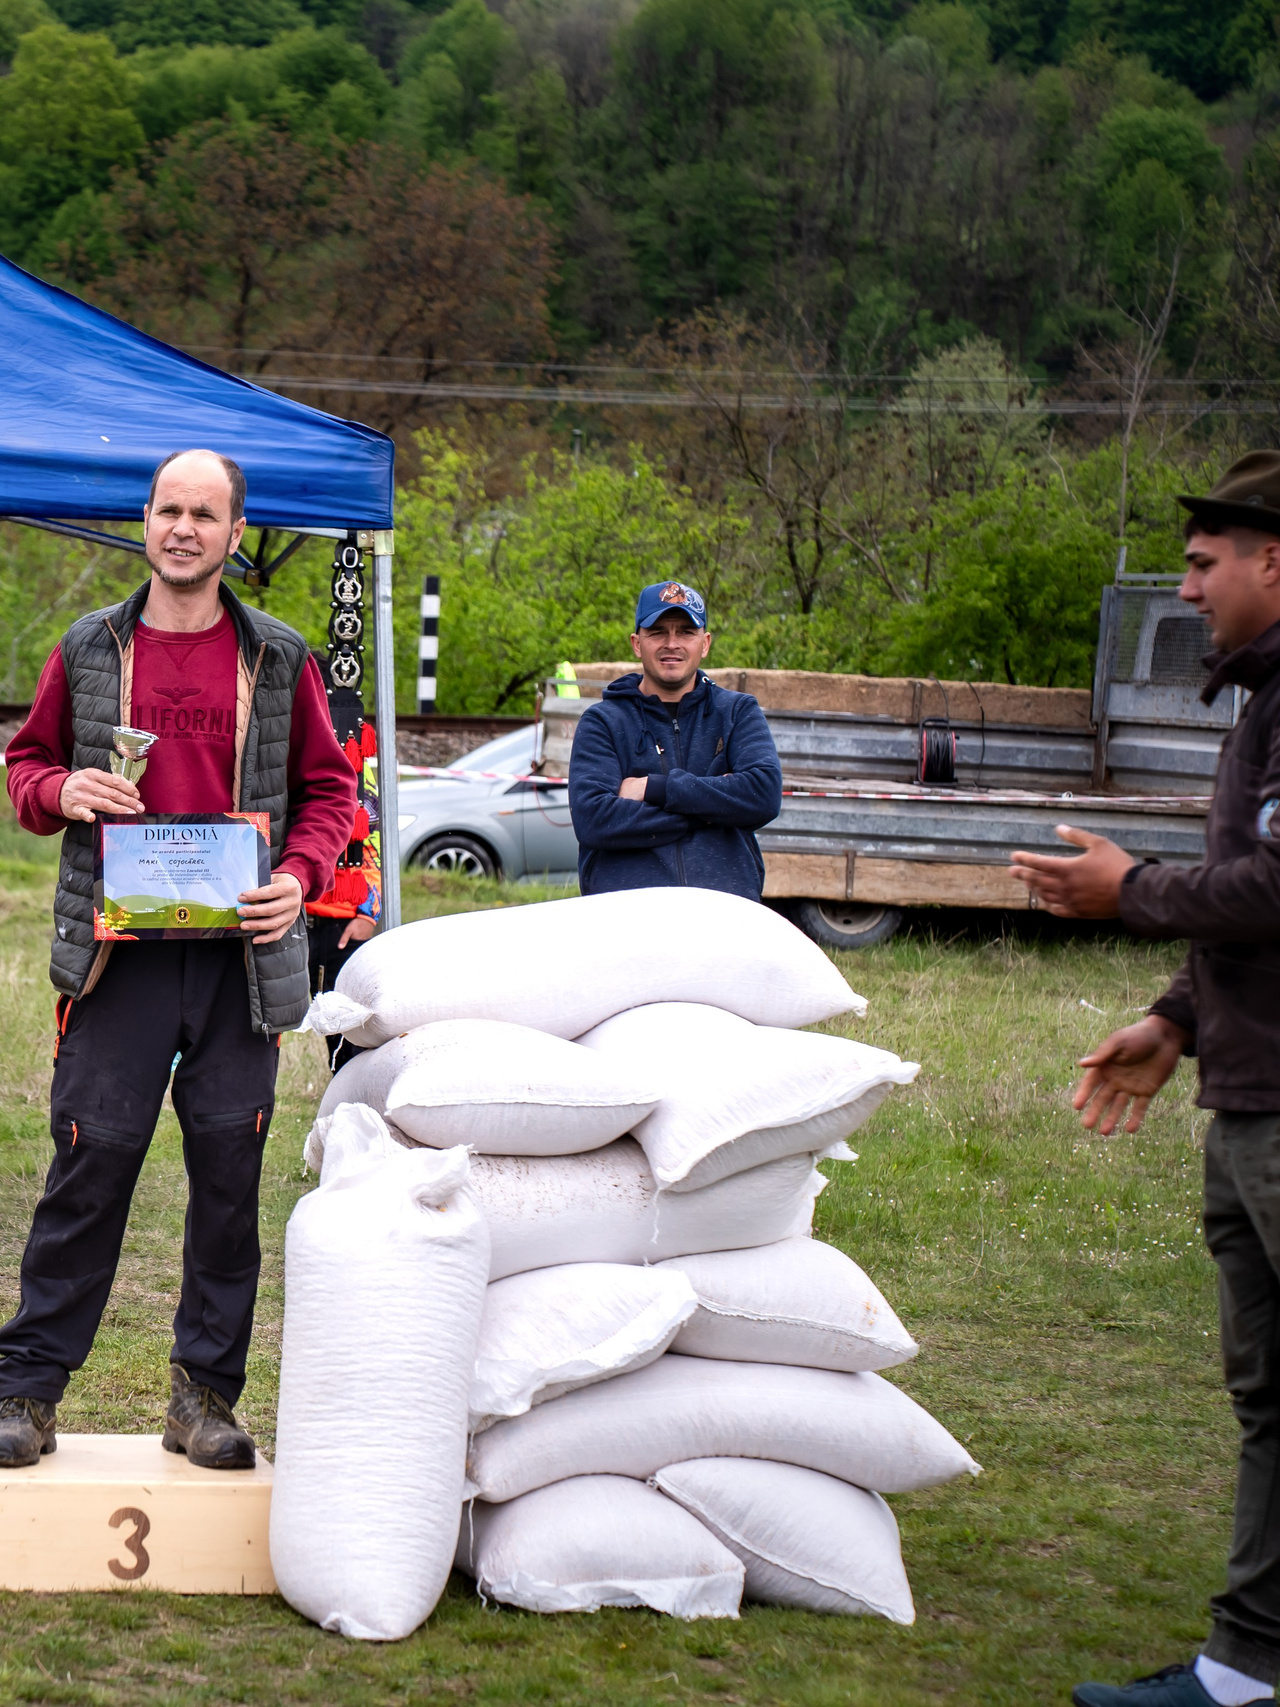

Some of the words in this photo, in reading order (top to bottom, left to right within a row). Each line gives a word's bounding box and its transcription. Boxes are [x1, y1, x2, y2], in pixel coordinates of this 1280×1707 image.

[136, 705, 232, 734] LIFORNI
[144, 826, 219, 841] DIPLOMĂ
[108, 1507, 151, 1581] 3
